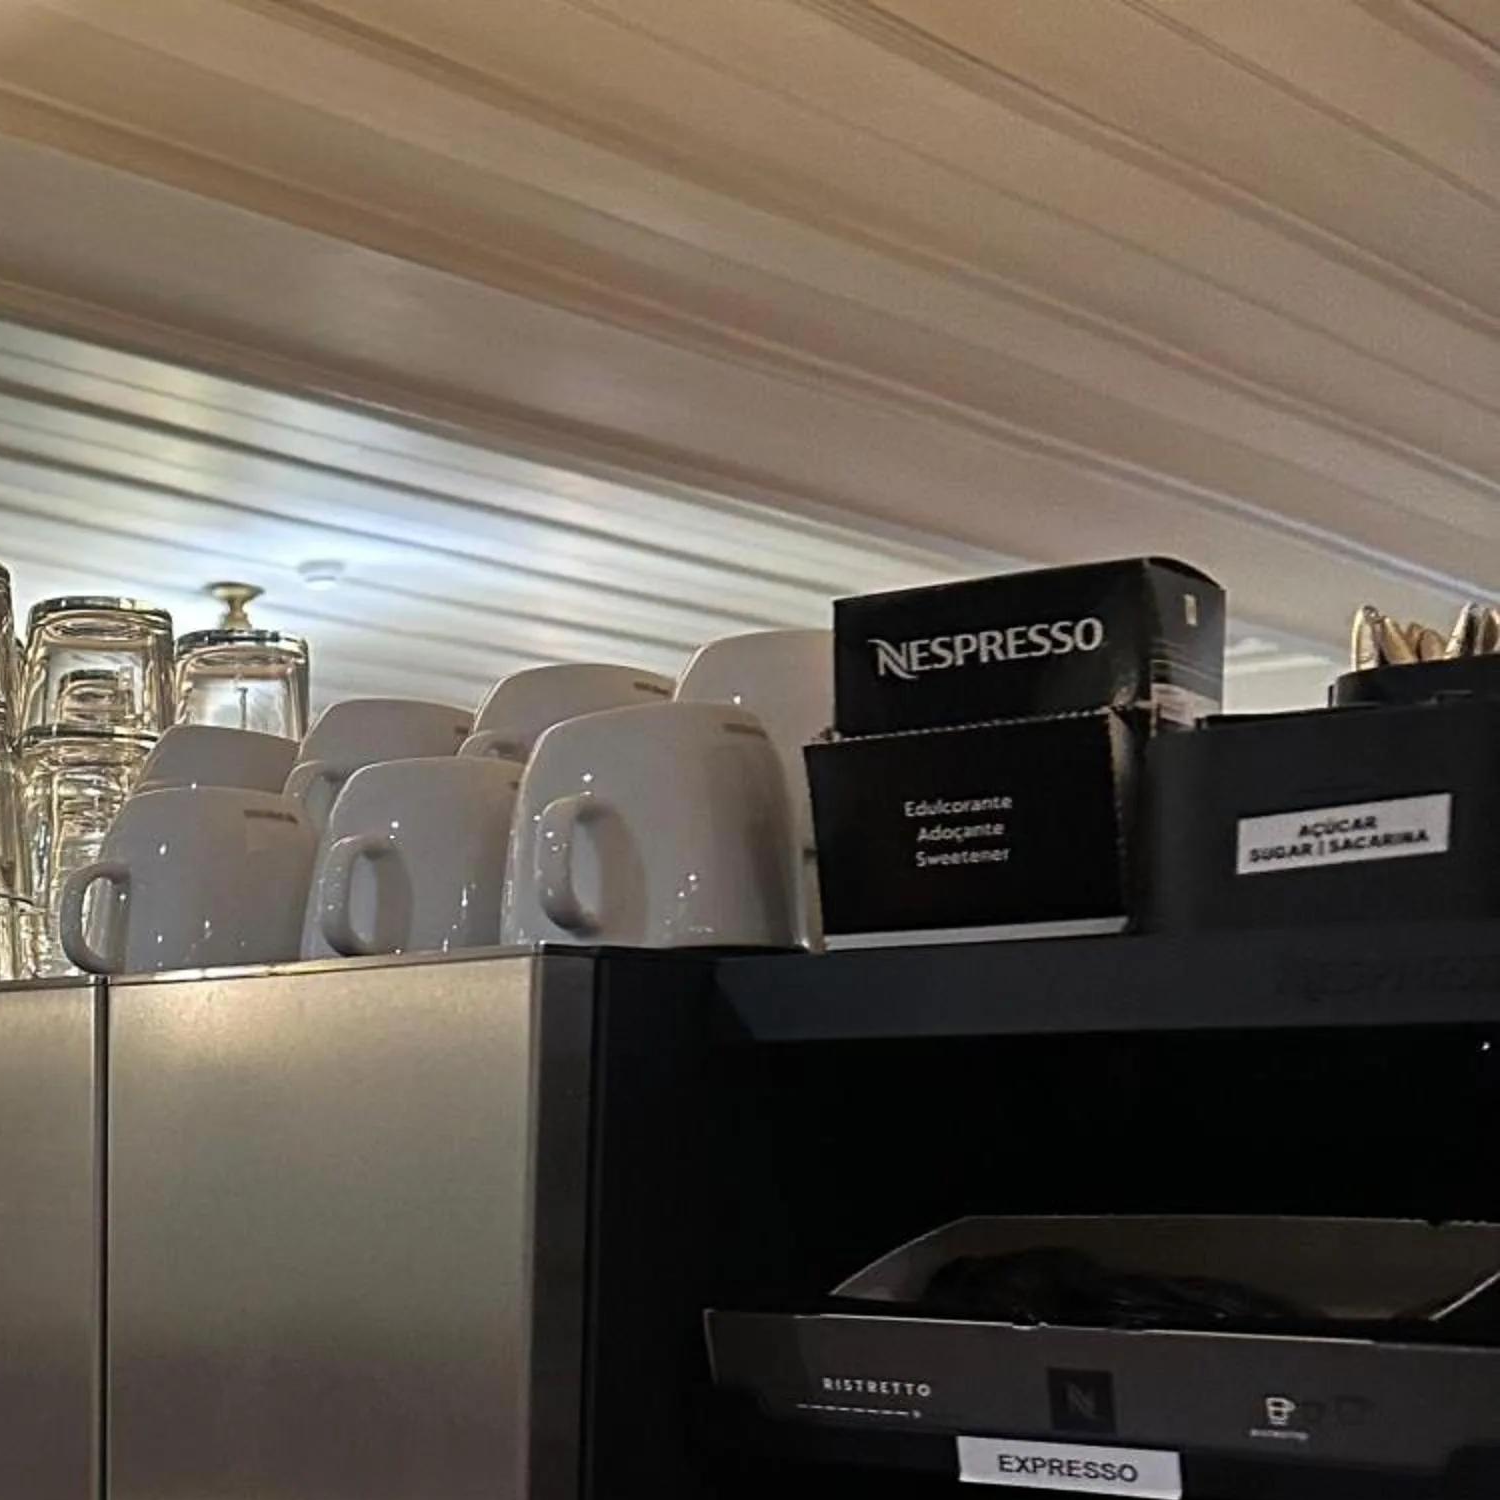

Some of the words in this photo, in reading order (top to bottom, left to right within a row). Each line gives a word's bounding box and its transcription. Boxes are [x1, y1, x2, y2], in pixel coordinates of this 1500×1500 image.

[867, 616, 1105, 681] NESPRESSO
[903, 792, 1014, 818] Edulcorante
[917, 819, 1006, 847] Adoçante
[1298, 814, 1378, 838] AÇÚCAR
[915, 846, 1012, 869] Sweetener
[1249, 843, 1313, 864] SUGAR
[1329, 828, 1431, 854] SACARINA
[821, 1376, 933, 1398] RISTRETTO
[996, 1452, 1140, 1486] EXPRESSO
